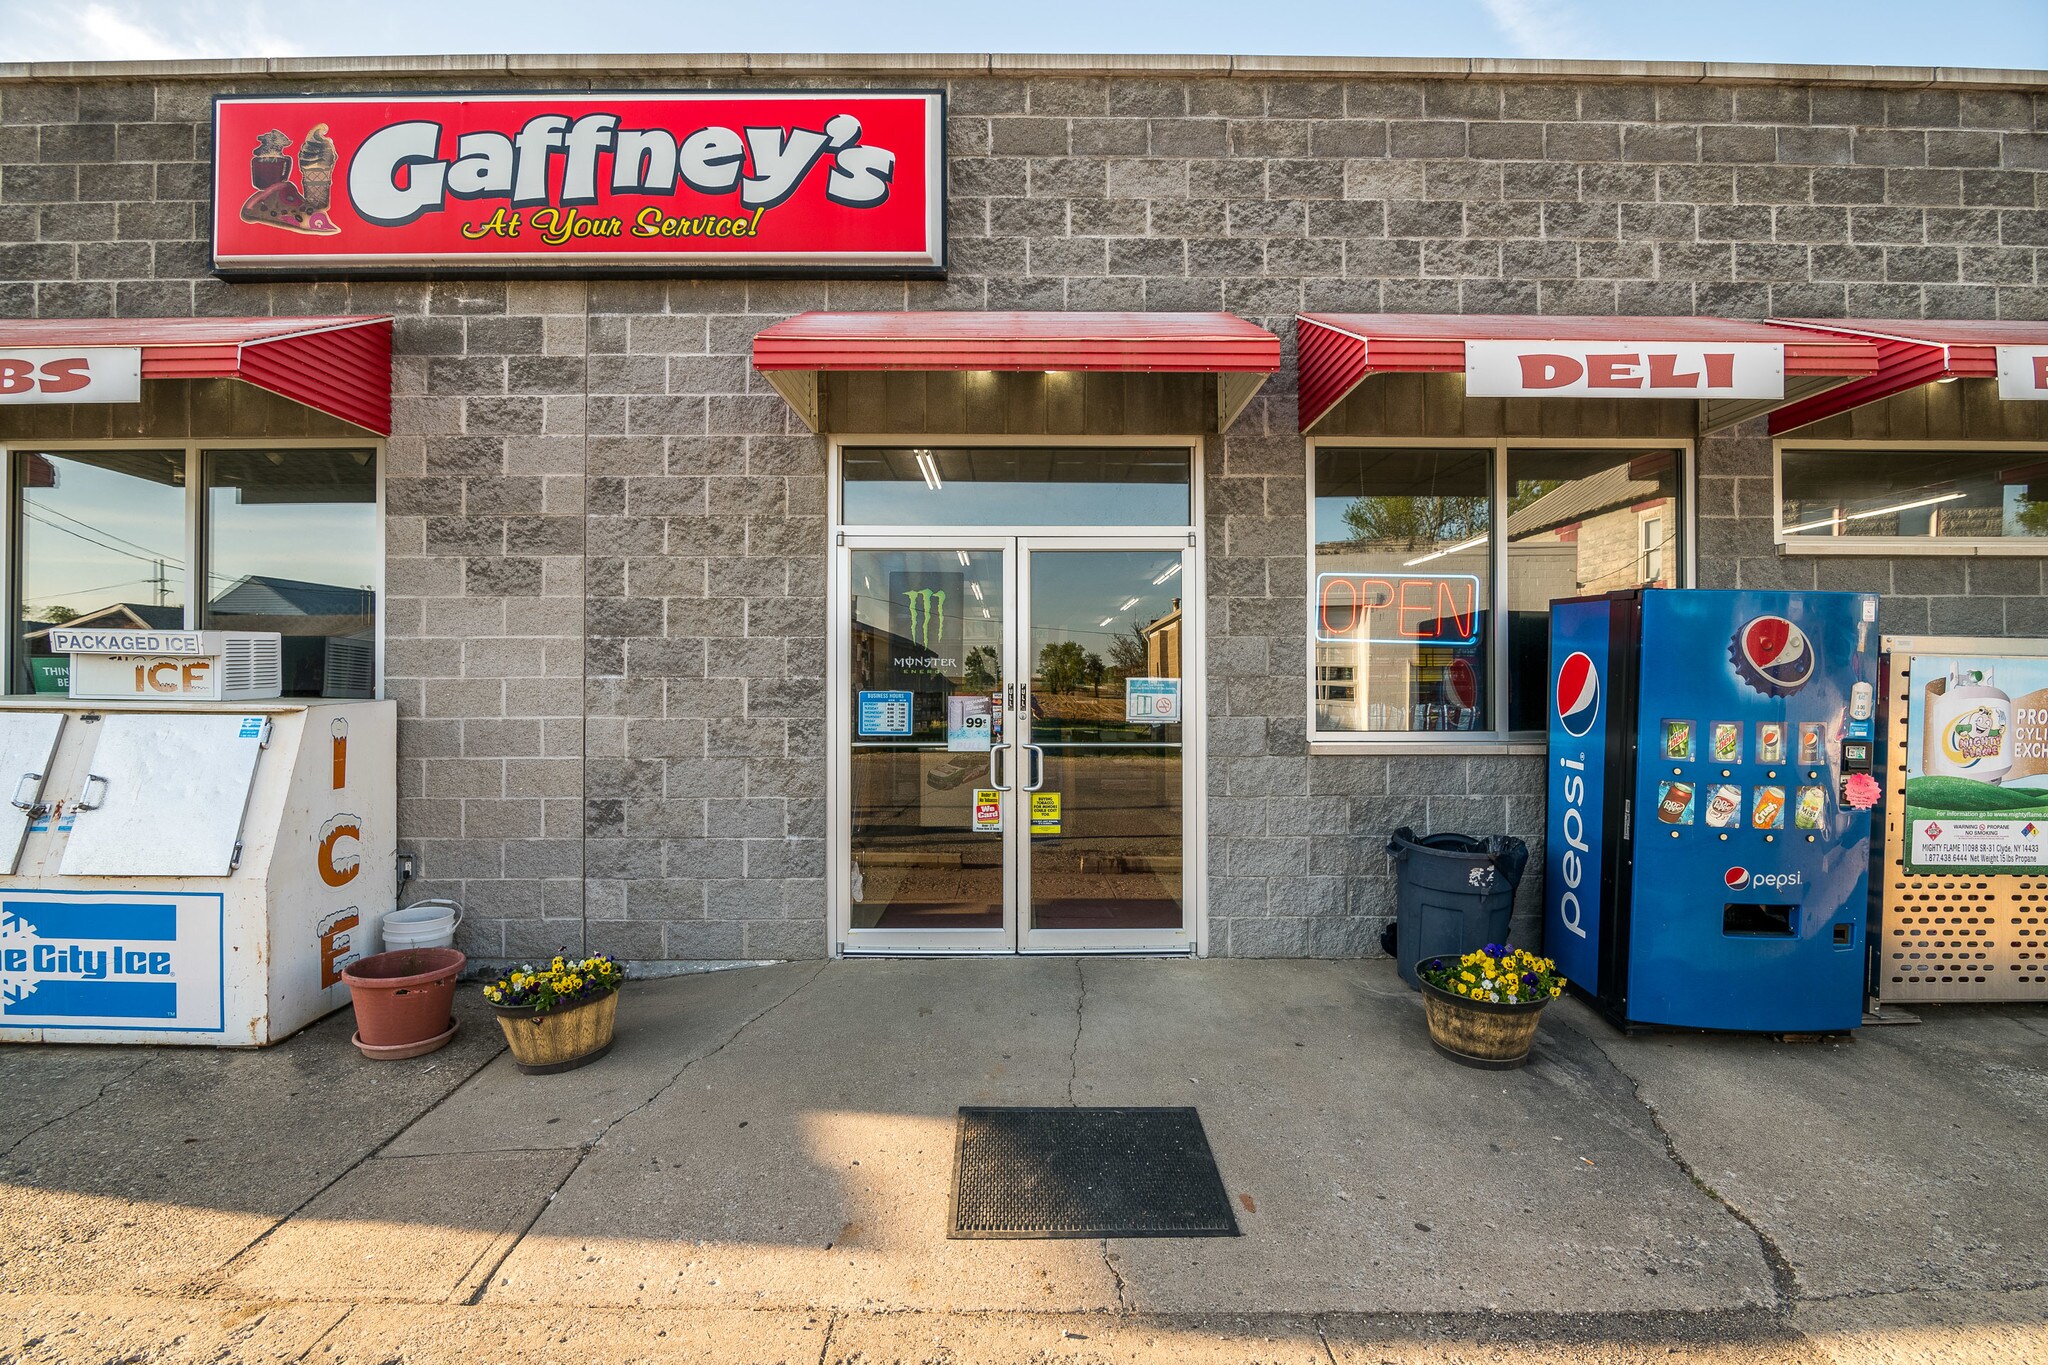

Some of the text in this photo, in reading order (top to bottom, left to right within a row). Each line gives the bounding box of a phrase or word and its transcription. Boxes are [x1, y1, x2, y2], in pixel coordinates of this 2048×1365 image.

[348, 113, 895, 227] Gaffney's
[463, 207, 763, 244] At Your Service!
[1518, 354, 1735, 388] DELI
[1322, 579, 1472, 638] OPEN
[57, 634, 196, 651] PACKAGED ICE
[894, 656, 957, 668] MONSTER
[1959, 736, 2001, 750] MIGHTY
[1963, 746, 1998, 759] FLAME
[1560, 755, 1588, 939] pepsi
[1962, 844, 1978, 852] 11098
[1979, 844, 1995, 852] SR-31
[1980, 854, 1999, 864] Weight
[2015, 855, 2036, 864] Propane
[1753, 871, 1800, 889] pepsi
[33, 944, 107, 979] City
[114, 946, 170, 975] Ice
